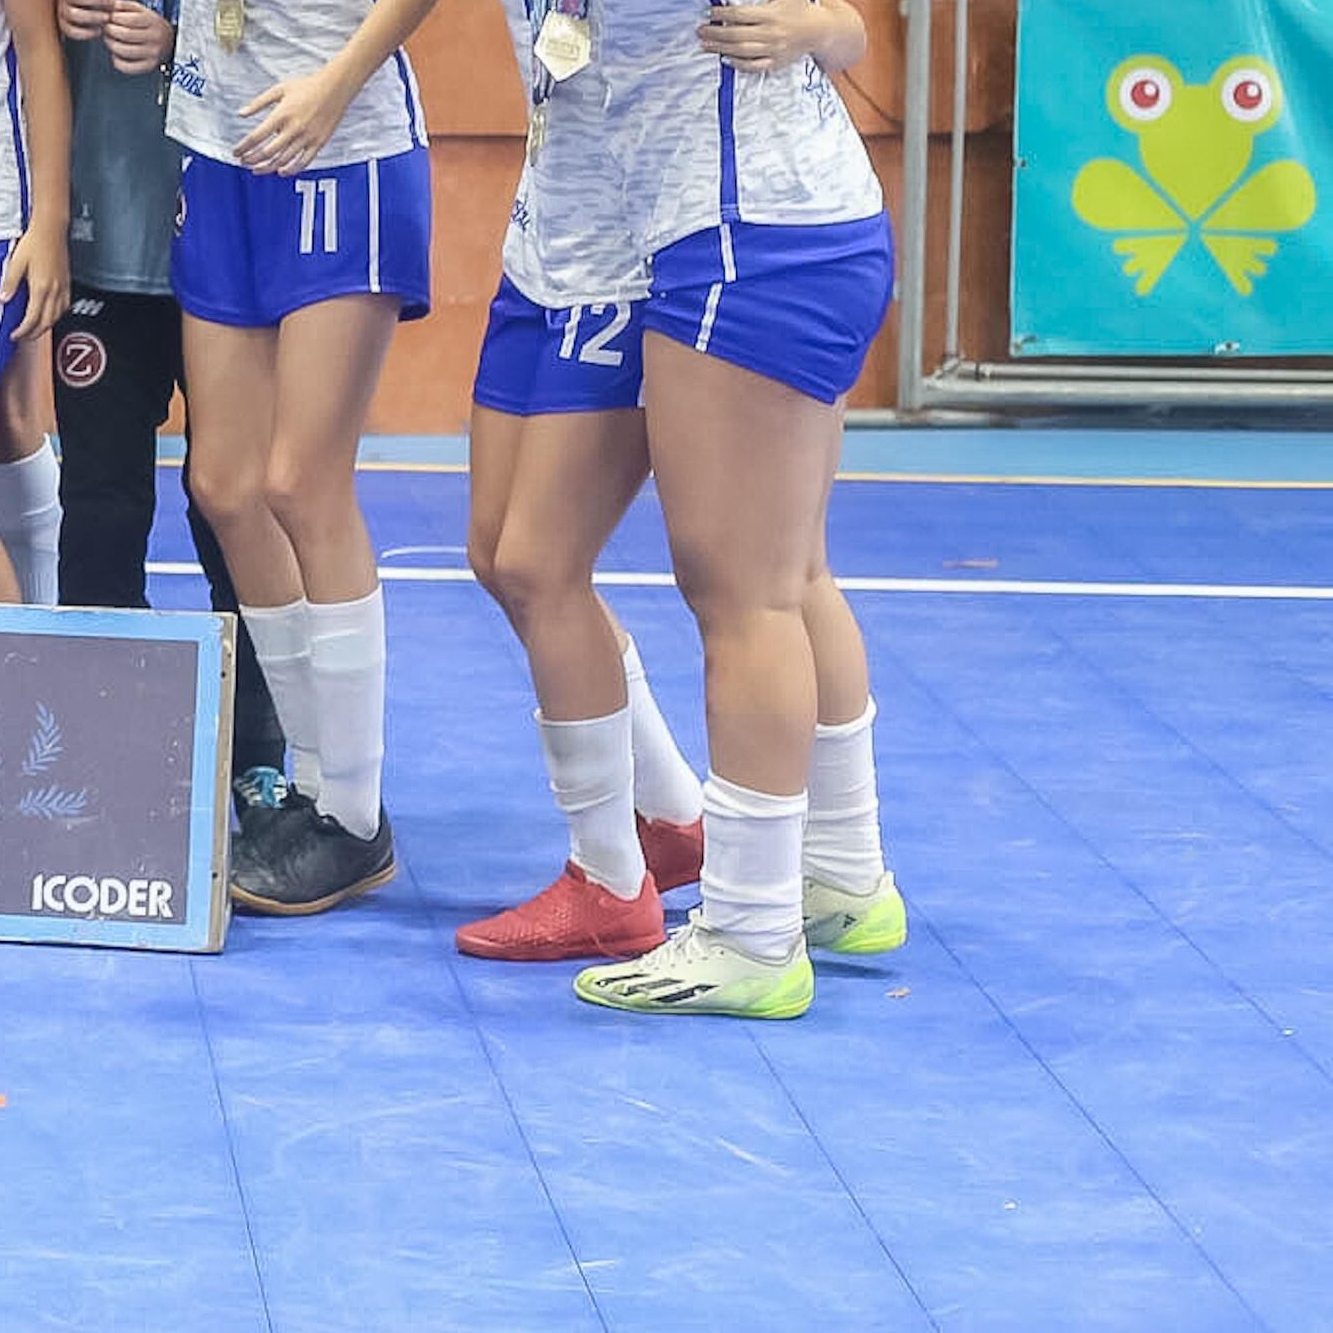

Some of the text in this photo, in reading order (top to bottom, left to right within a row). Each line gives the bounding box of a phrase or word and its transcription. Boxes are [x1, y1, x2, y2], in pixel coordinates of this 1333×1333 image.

[295, 178, 337, 253] 11
[66, 344, 92, 376] Z
[559, 301, 631, 366] 12
[32, 873, 174, 919] ICODER
